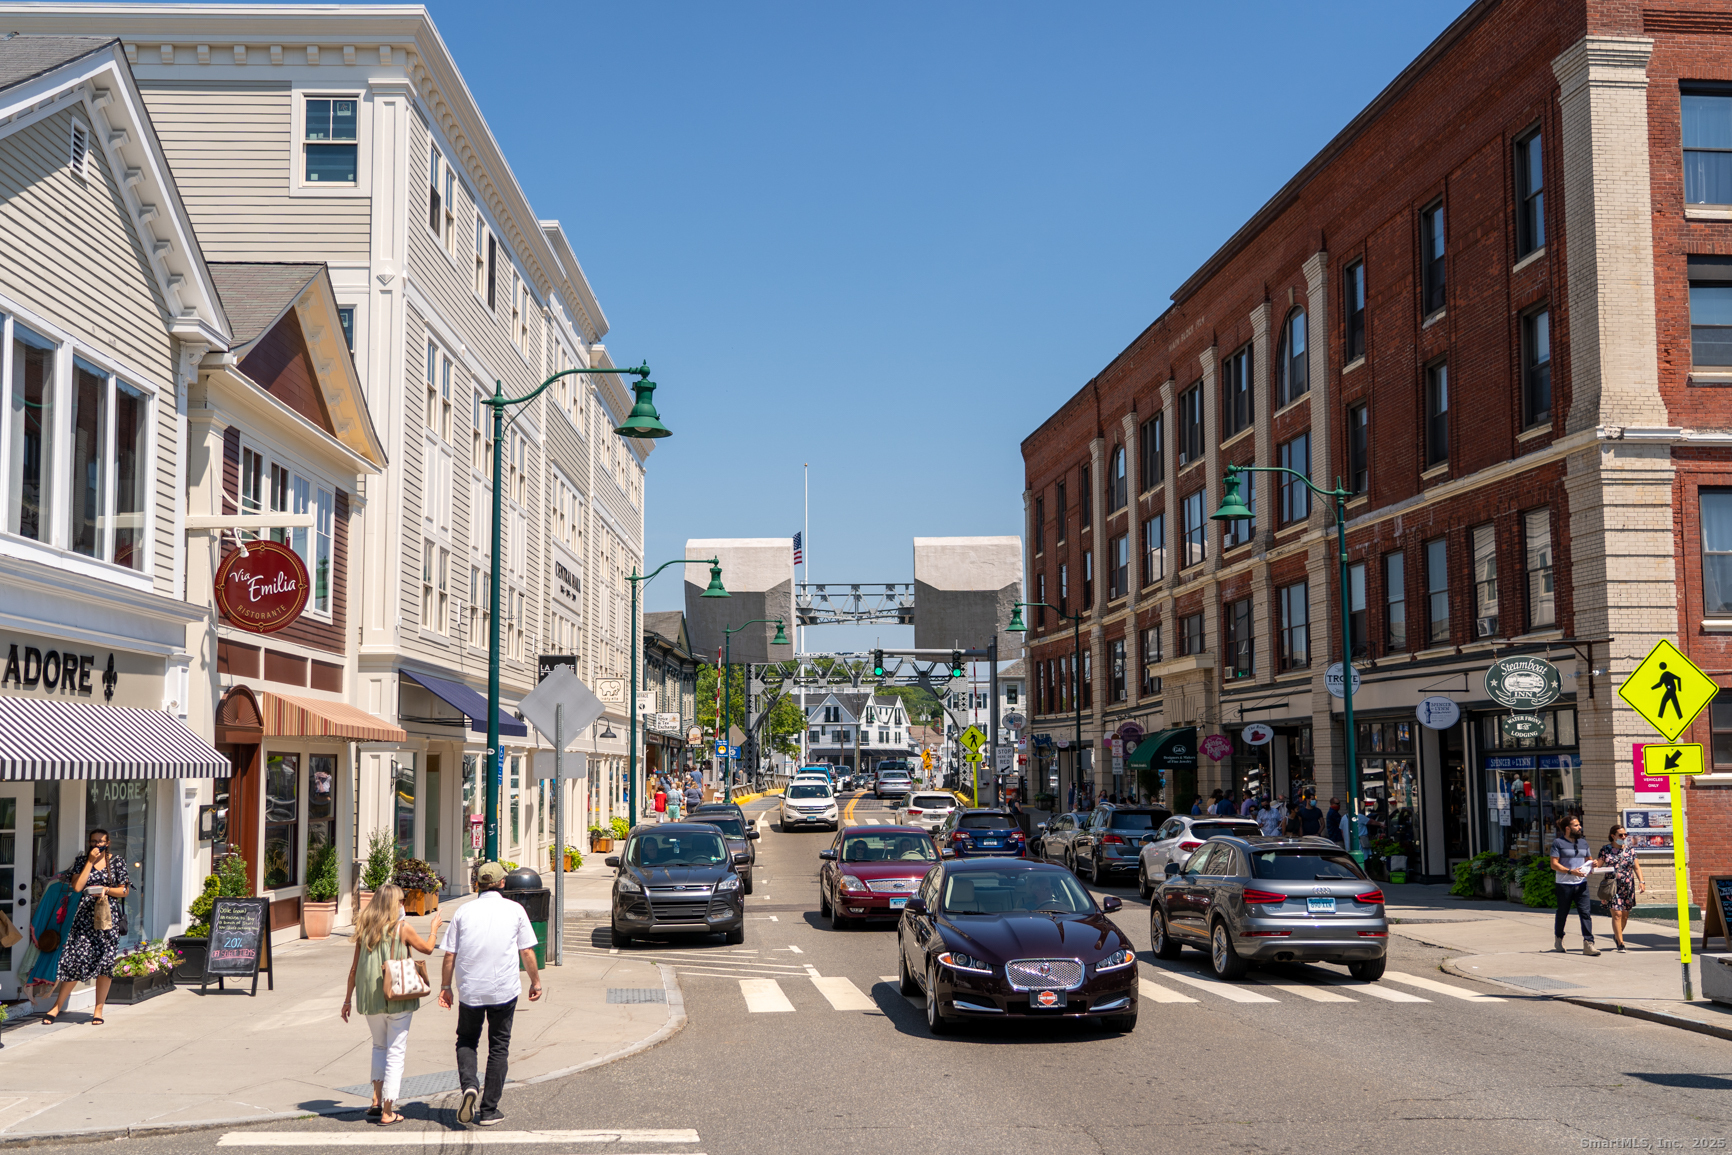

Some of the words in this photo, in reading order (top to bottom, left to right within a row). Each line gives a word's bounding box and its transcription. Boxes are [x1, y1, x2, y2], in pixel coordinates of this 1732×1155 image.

[1181, 324, 1194, 342] BLOCK
[229, 568, 250, 582] Via
[247, 571, 297, 602] Emilia
[237, 604, 287, 620] RISTORANTE
[1, 644, 95, 695] ADORE
[1500, 658, 1548, 675] Steamboat
[1507, 716, 1525, 724] WATER
[1524, 715, 1542, 725] FRONT
[1510, 730, 1538, 738] LODGING
[1490, 758, 1511, 767] SPENCER
[1515, 757, 1532, 767] LYNN
[103, 782, 142, 801] ADORE
[220, 905, 232, 914] Sale
[223, 937, 243, 948] 20%
[239, 948, 256, 957] ITEMS
